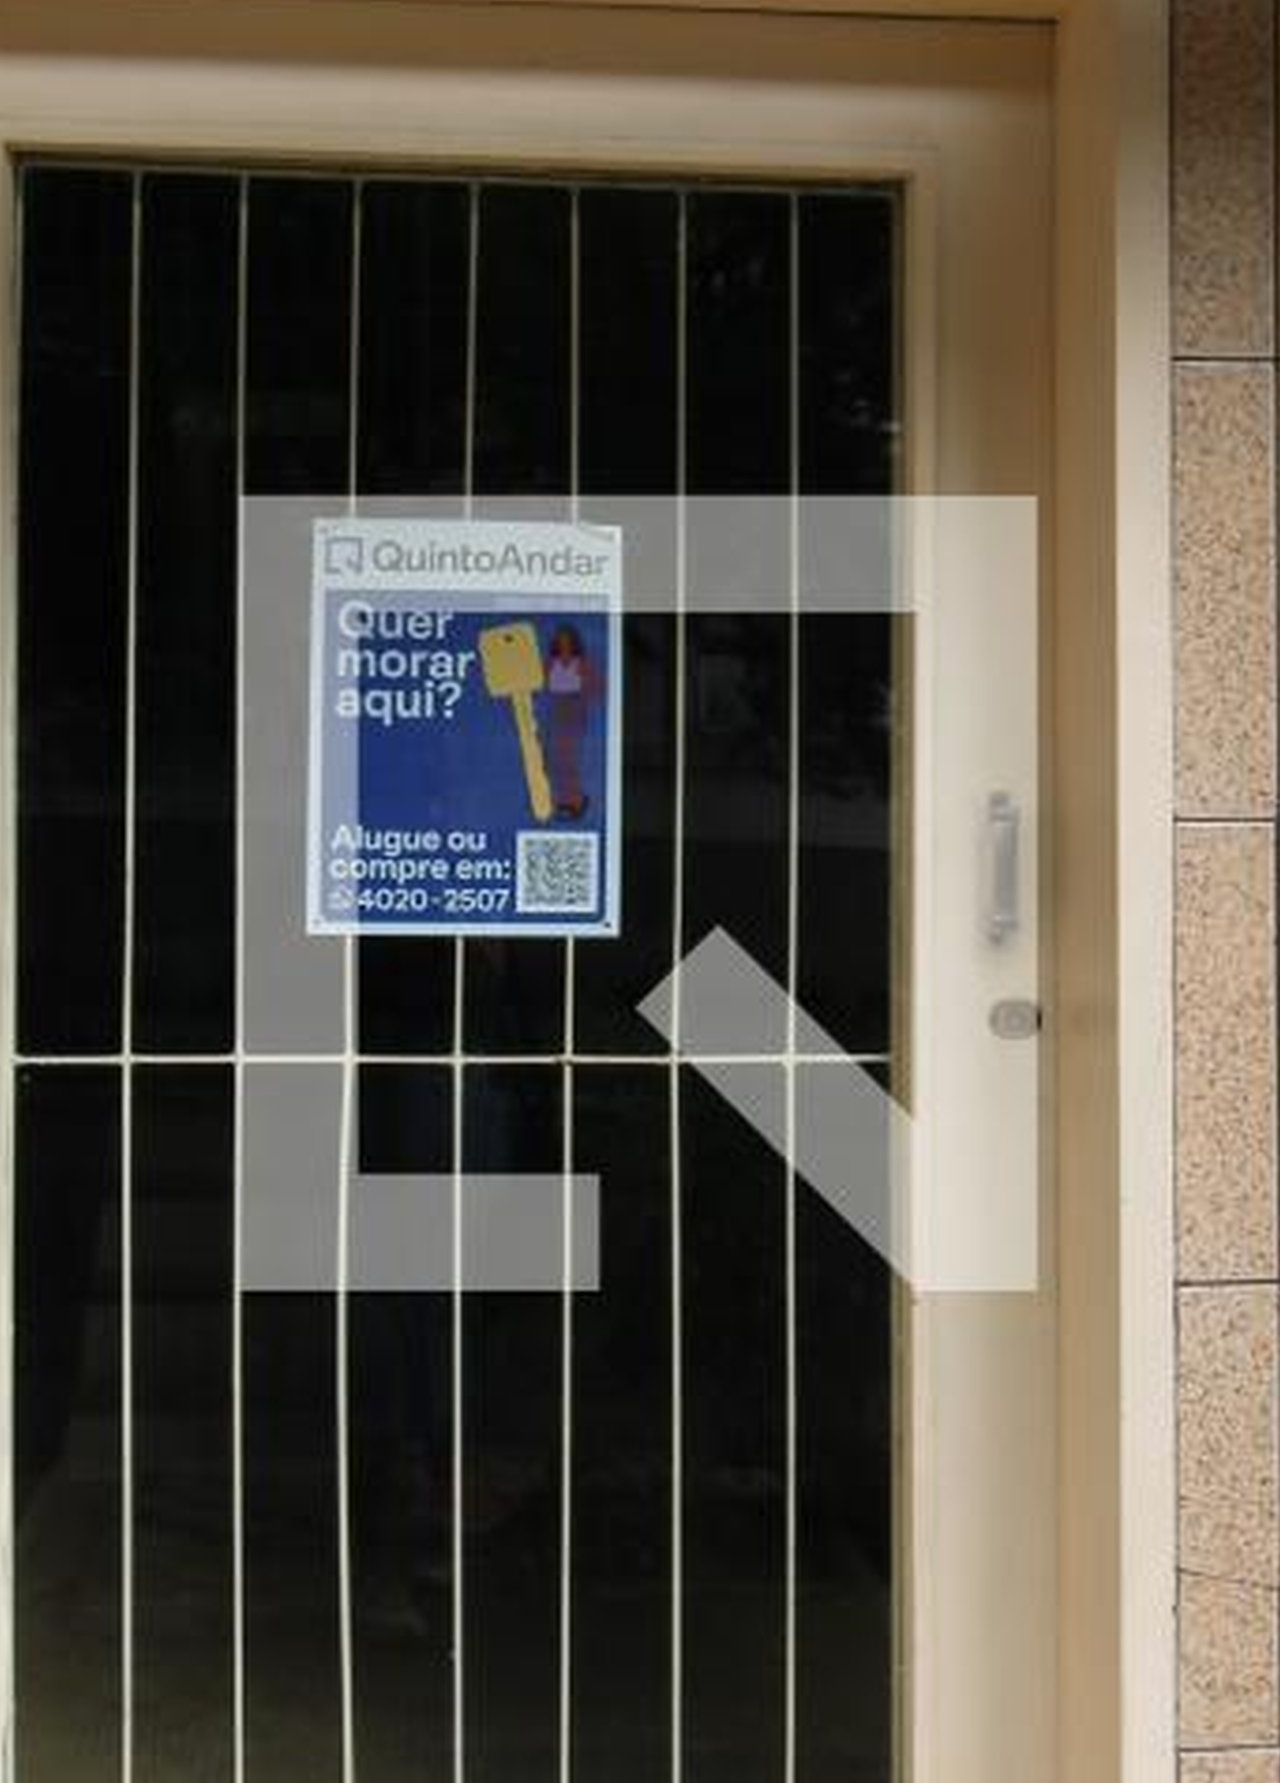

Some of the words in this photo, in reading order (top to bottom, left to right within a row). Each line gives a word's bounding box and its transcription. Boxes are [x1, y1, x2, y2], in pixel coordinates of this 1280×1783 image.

[372, 541, 610, 577] QuintoAndar
[339, 600, 453, 640] Quer
[336, 647, 475, 679] morar
[335, 683, 462, 725] aqui?
[330, 824, 442, 857] Alugue
[447, 831, 488, 852] ou
[330, 858, 450, 885] compre
[455, 859, 511, 880] em:
